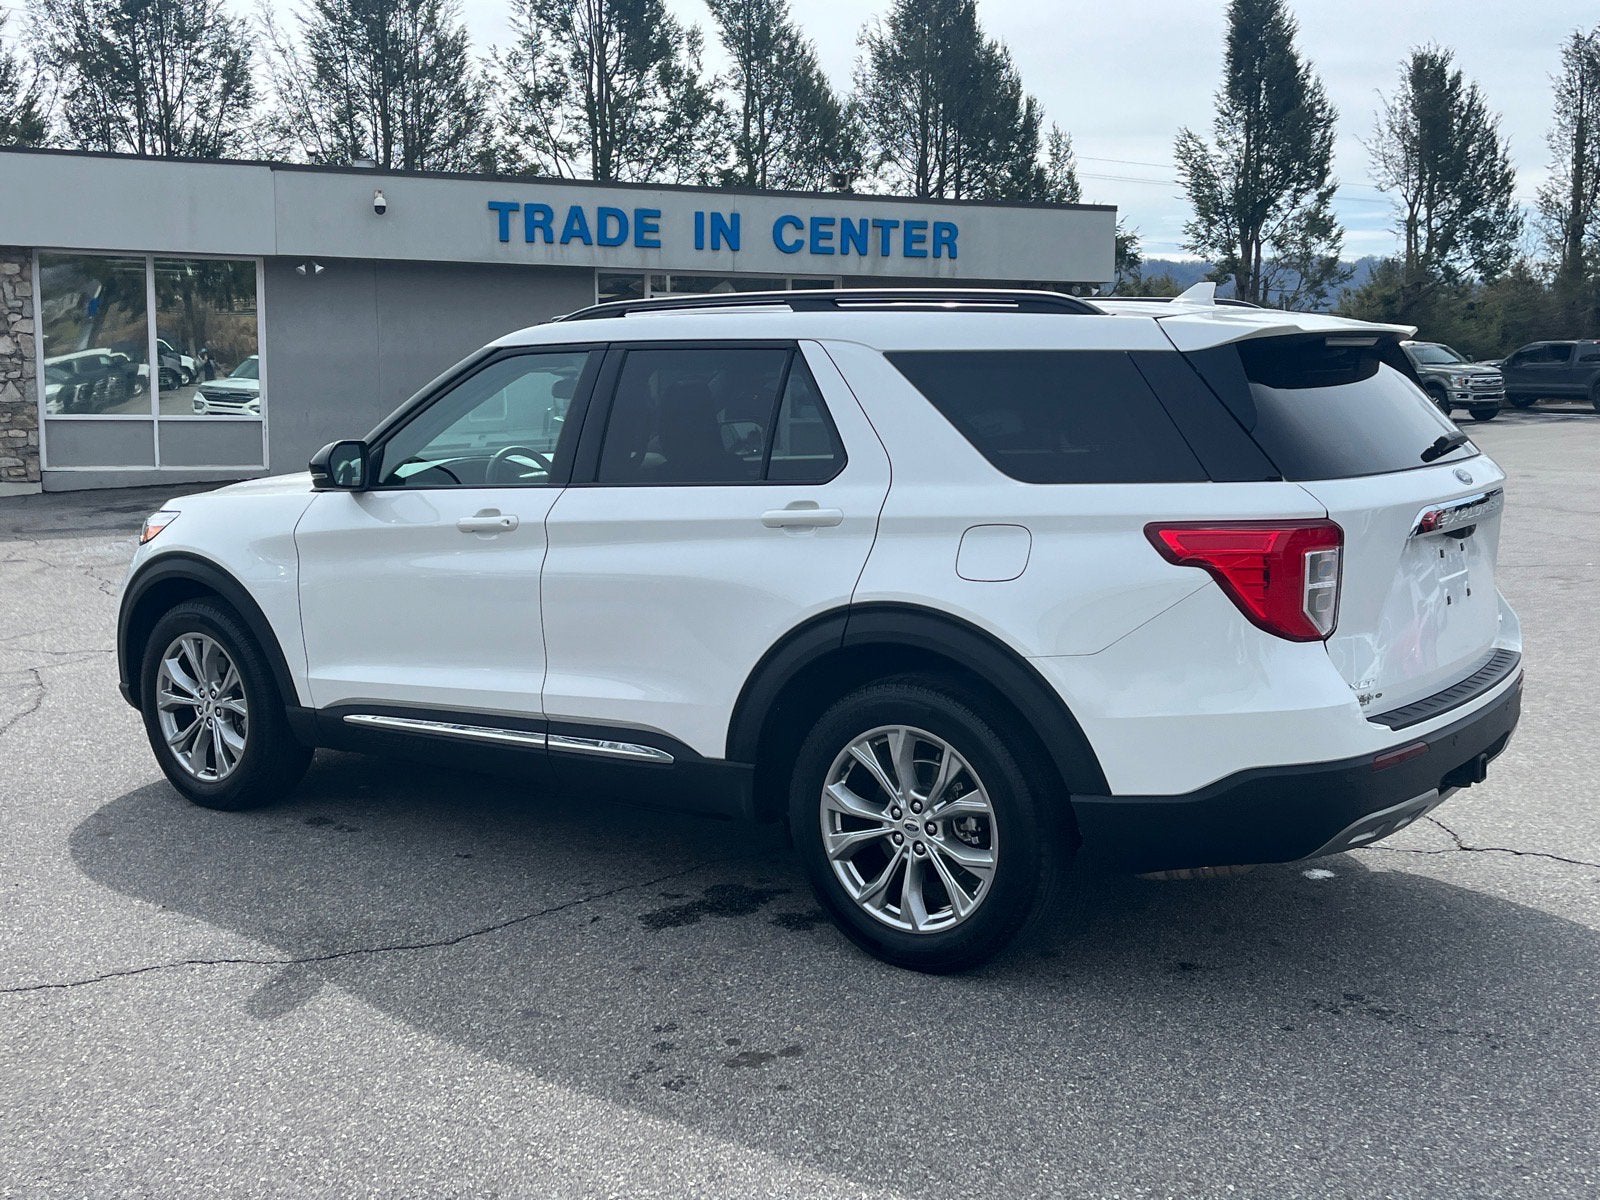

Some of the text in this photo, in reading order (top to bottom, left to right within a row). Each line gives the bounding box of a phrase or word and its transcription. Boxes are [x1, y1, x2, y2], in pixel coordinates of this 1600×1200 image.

[488, 201, 959, 259] TRADE IN CENTER
